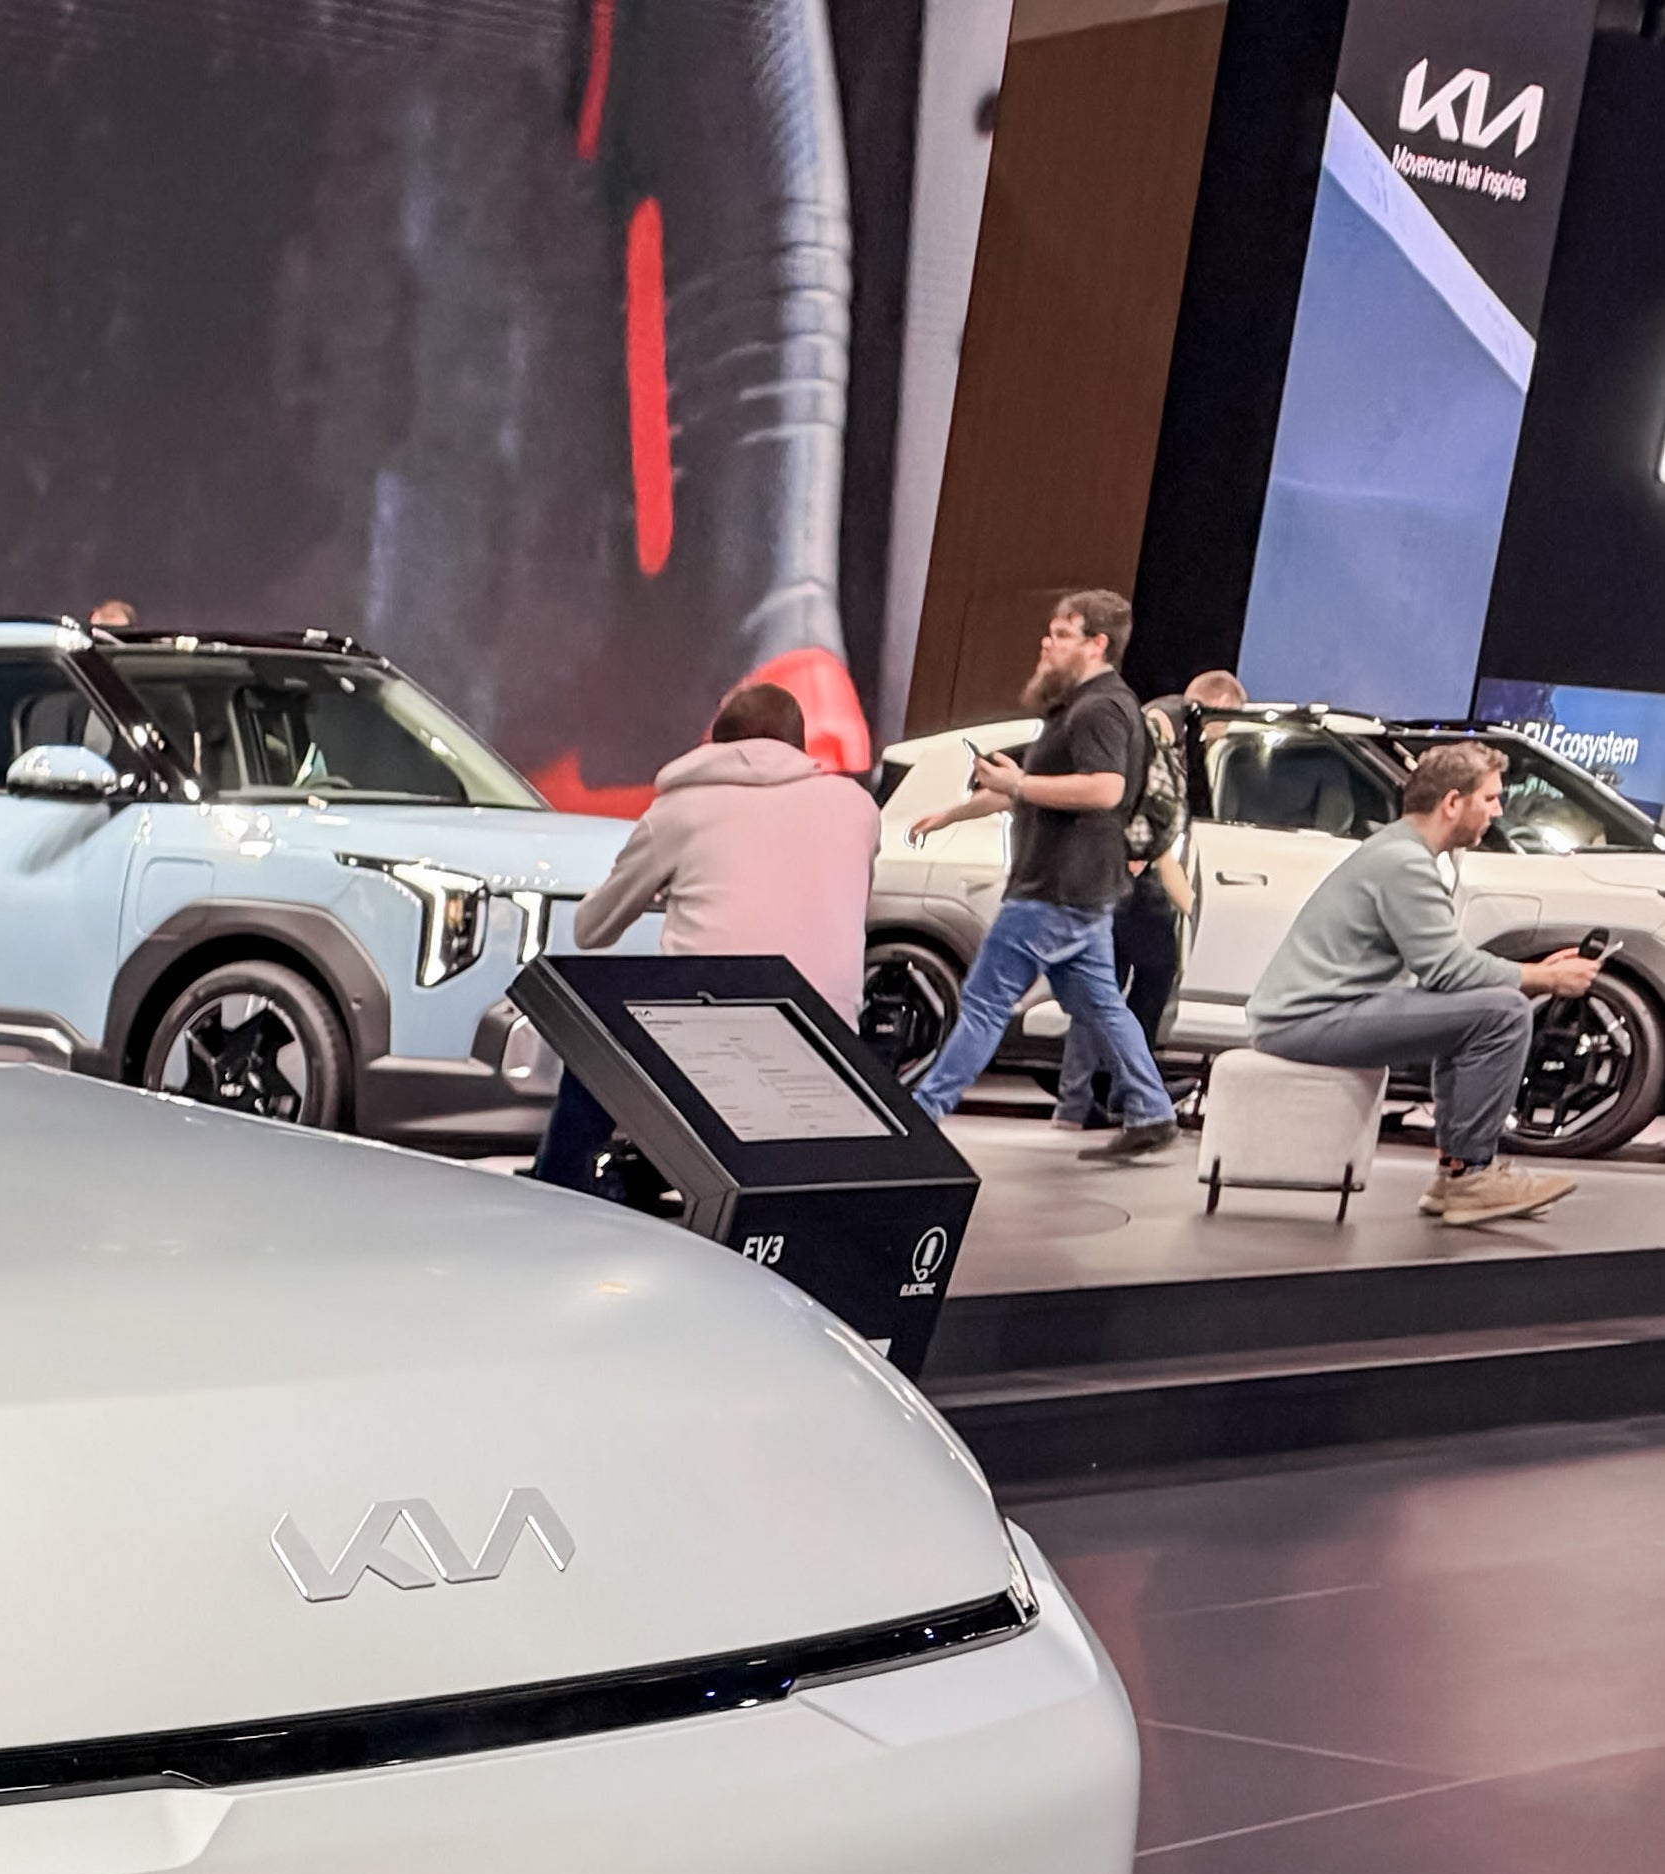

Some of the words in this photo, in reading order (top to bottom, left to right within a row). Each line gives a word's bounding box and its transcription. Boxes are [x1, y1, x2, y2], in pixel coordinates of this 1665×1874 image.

[1398, 57, 1544, 159] KIA
[1391, 143, 1457, 186] Movement
[1455, 158, 1483, 191] that
[1481, 166, 1527, 202] inspires
[1549, 723, 1639, 769] Ecosystem
[742, 1235, 784, 1265] EV3
[270, 1487, 576, 1603] KIA
